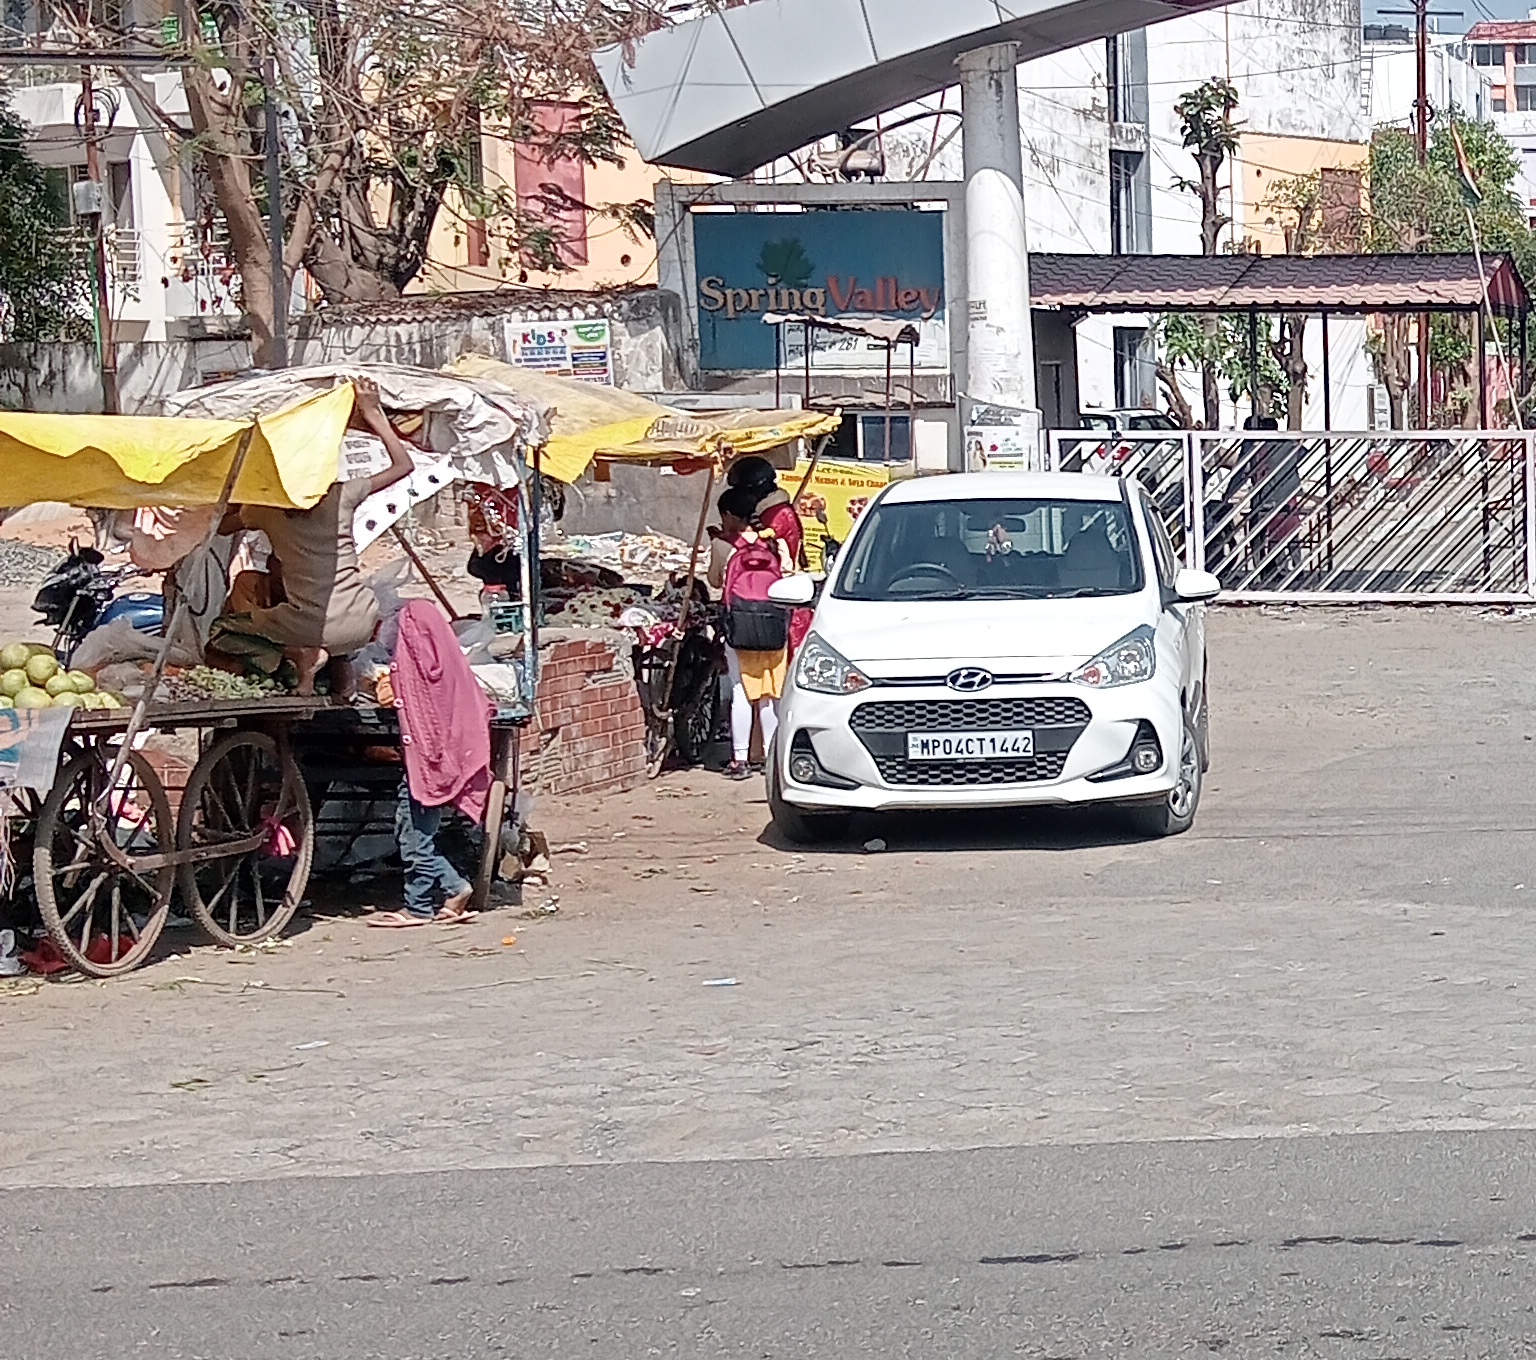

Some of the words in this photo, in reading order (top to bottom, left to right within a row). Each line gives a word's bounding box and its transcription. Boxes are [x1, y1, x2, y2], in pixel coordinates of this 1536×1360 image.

[700, 275, 826, 319] Spring
[827, 276, 940, 320] Valley
[921, 736, 1032, 756] MP04CT1442
